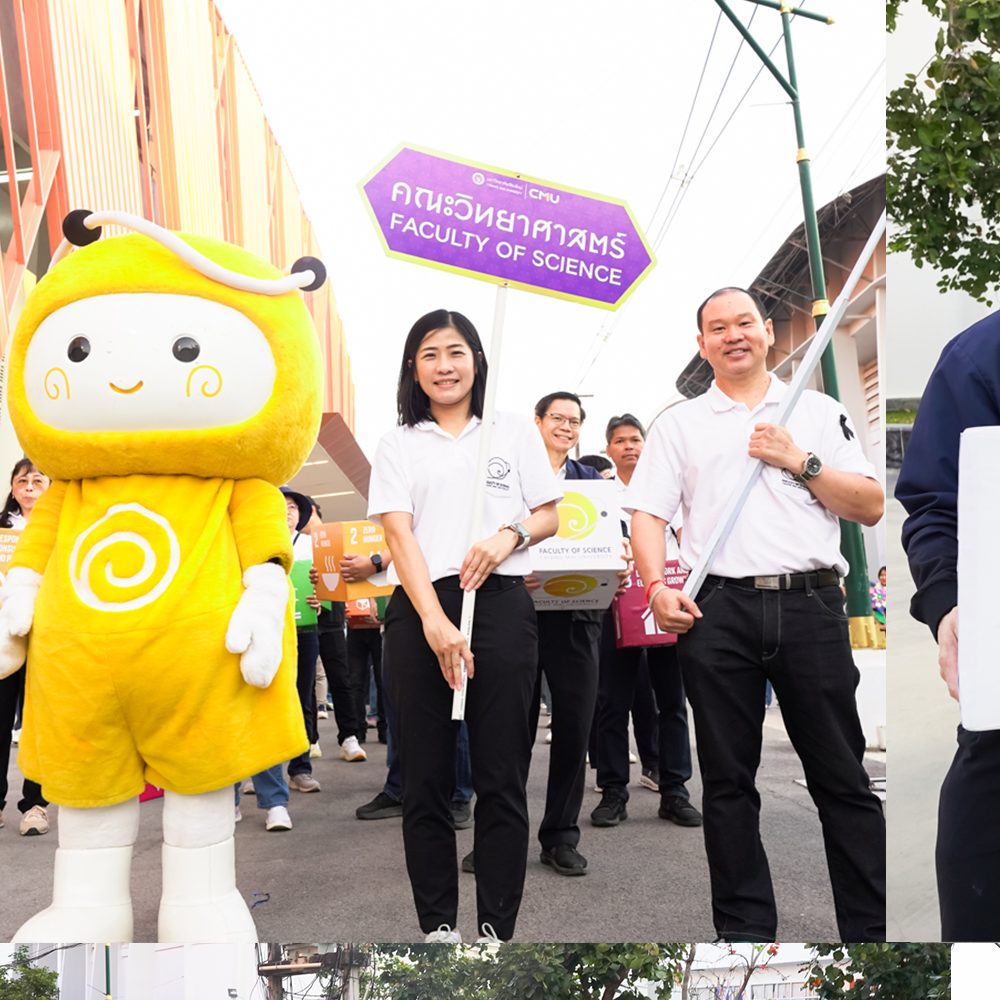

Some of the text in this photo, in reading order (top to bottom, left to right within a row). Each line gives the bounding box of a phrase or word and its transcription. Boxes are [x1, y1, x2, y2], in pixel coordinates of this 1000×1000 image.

[528, 188, 560, 204] CMU
[390, 181, 628, 260] คณะวิทยาศาสตร์
[389, 211, 623, 286] FACULTY OF SCIENCE
[350, 525, 376, 545] 2 ZERO
[539, 547, 569, 555] FACULTY
[582, 546, 612, 554] SCIENCE
